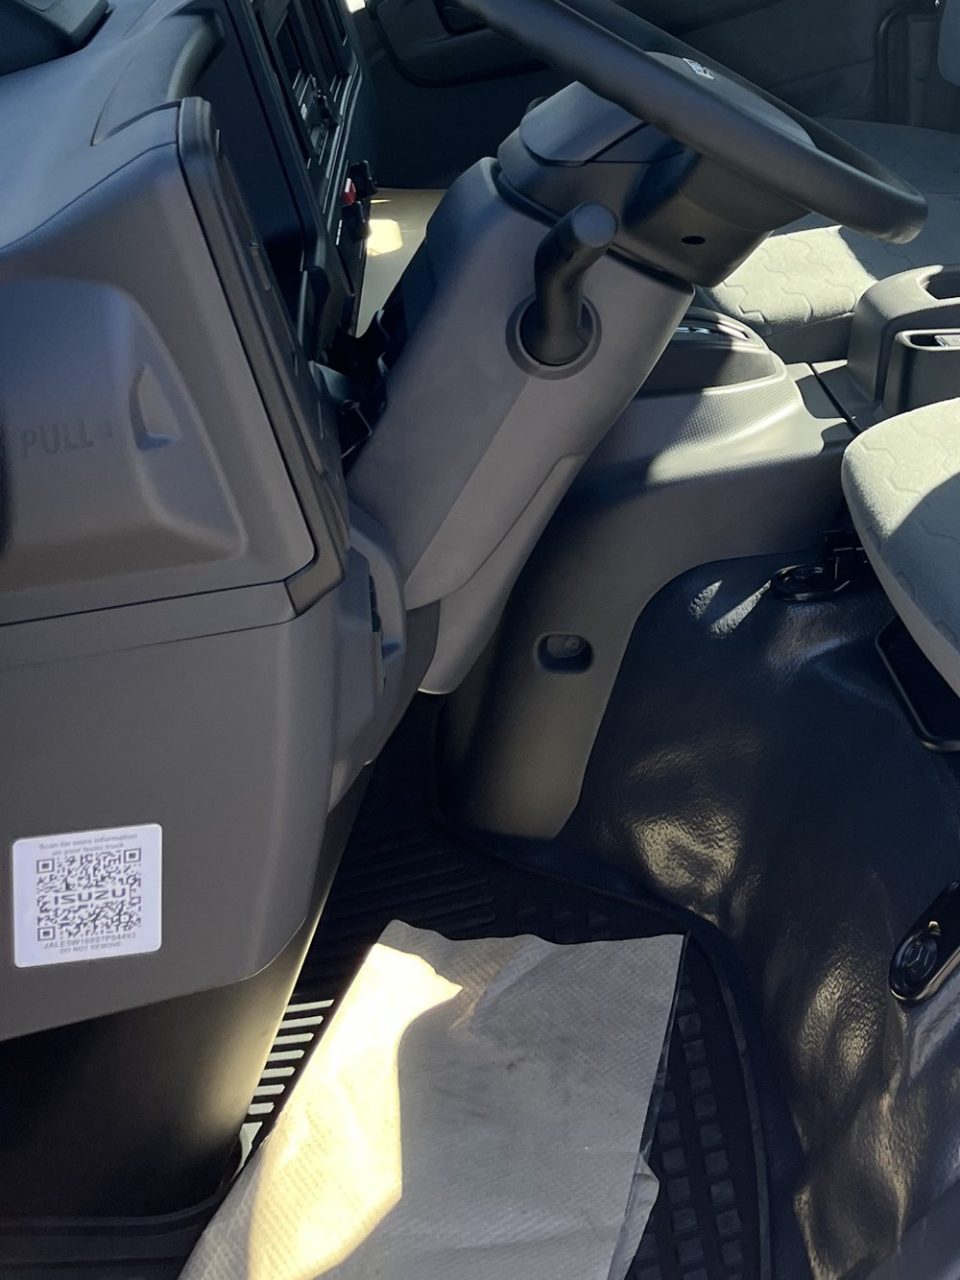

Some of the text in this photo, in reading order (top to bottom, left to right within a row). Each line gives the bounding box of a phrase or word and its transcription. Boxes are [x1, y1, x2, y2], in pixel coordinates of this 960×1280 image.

[20, 417, 96, 459] PULL
[94, 833, 137, 843] information
[54, 888, 126, 905] ISUZU
[90, 941, 120, 950] REMOVE
